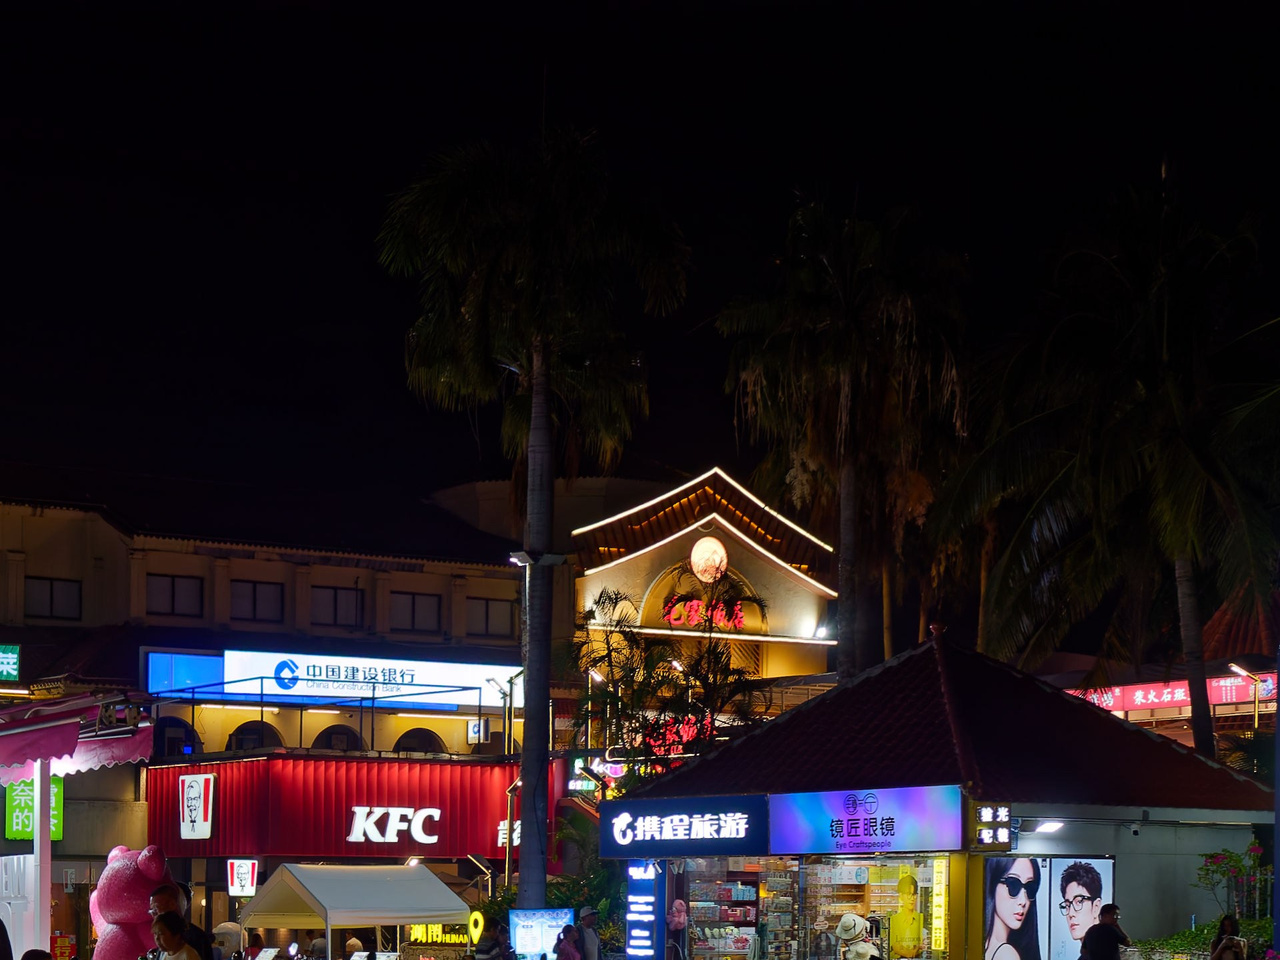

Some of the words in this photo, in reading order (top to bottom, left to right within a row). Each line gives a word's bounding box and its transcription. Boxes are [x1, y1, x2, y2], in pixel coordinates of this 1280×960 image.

[306, 664, 416, 684] 中国建设银行
[306, 680, 329, 689] China
[382, 684, 402, 693] Bank
[346, 806, 441, 844] KFC
[633, 812, 749, 842] 携程旅游
[829, 816, 896, 839] 镜匠眼镜
[835, 840, 848, 849] Eye
[848, 839, 892, 850] Craftspeople
